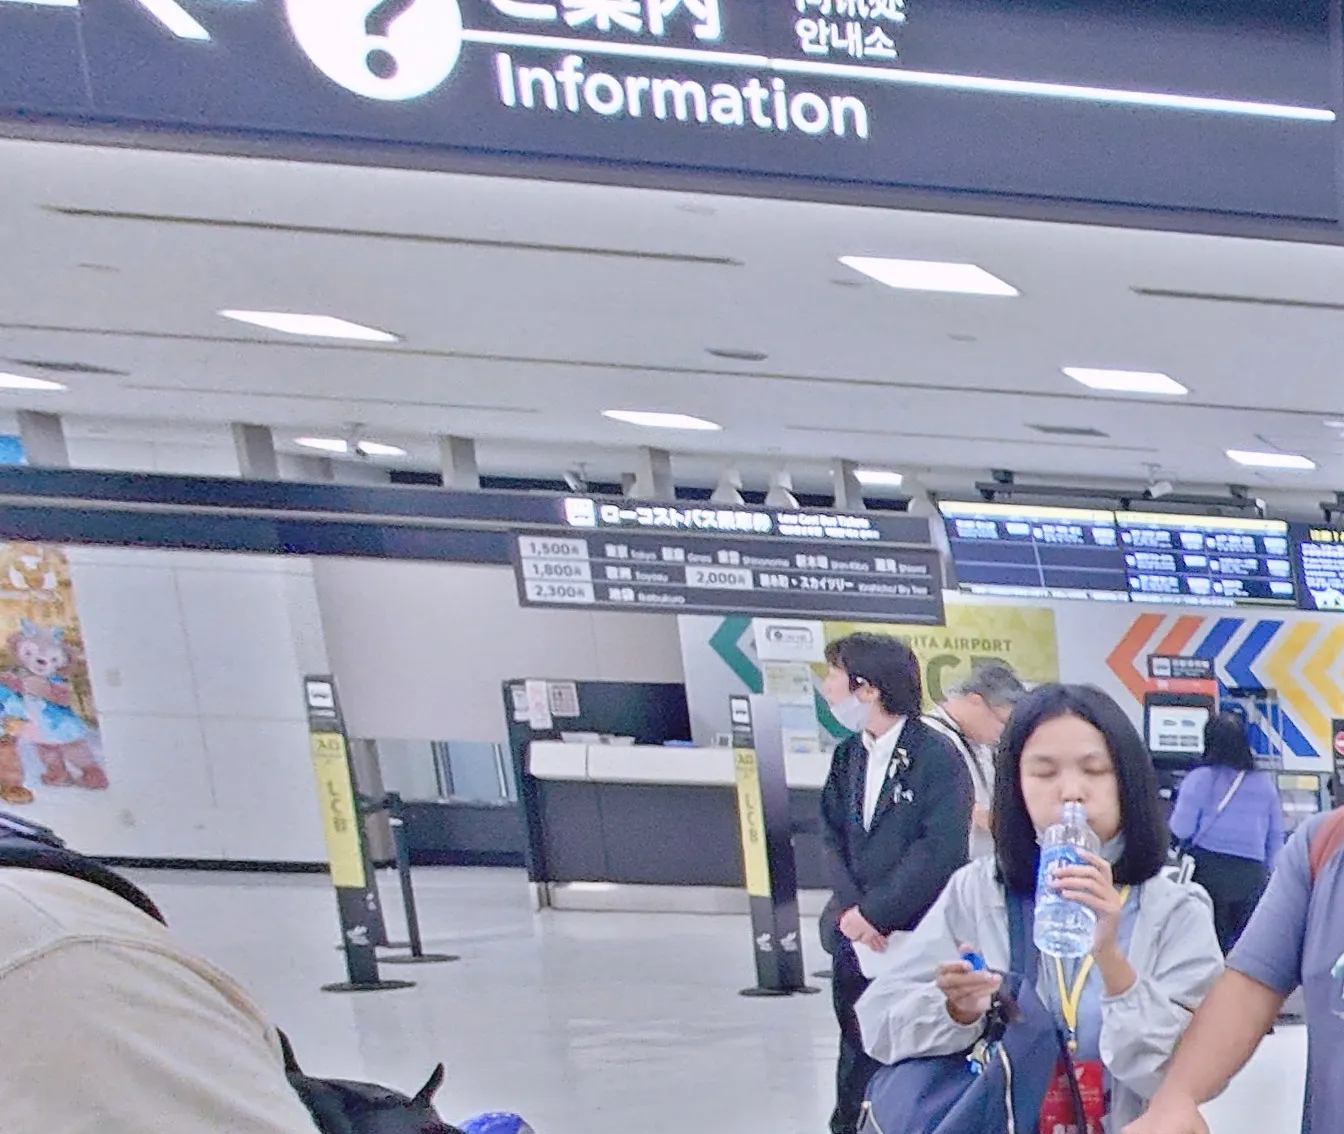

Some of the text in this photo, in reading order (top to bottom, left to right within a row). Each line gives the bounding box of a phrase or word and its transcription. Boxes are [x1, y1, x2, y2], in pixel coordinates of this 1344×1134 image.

[796, 18, 898, 58] 안내소
[496, 53, 870, 139] Information
[943, 637, 1013, 652] AIRPORT
